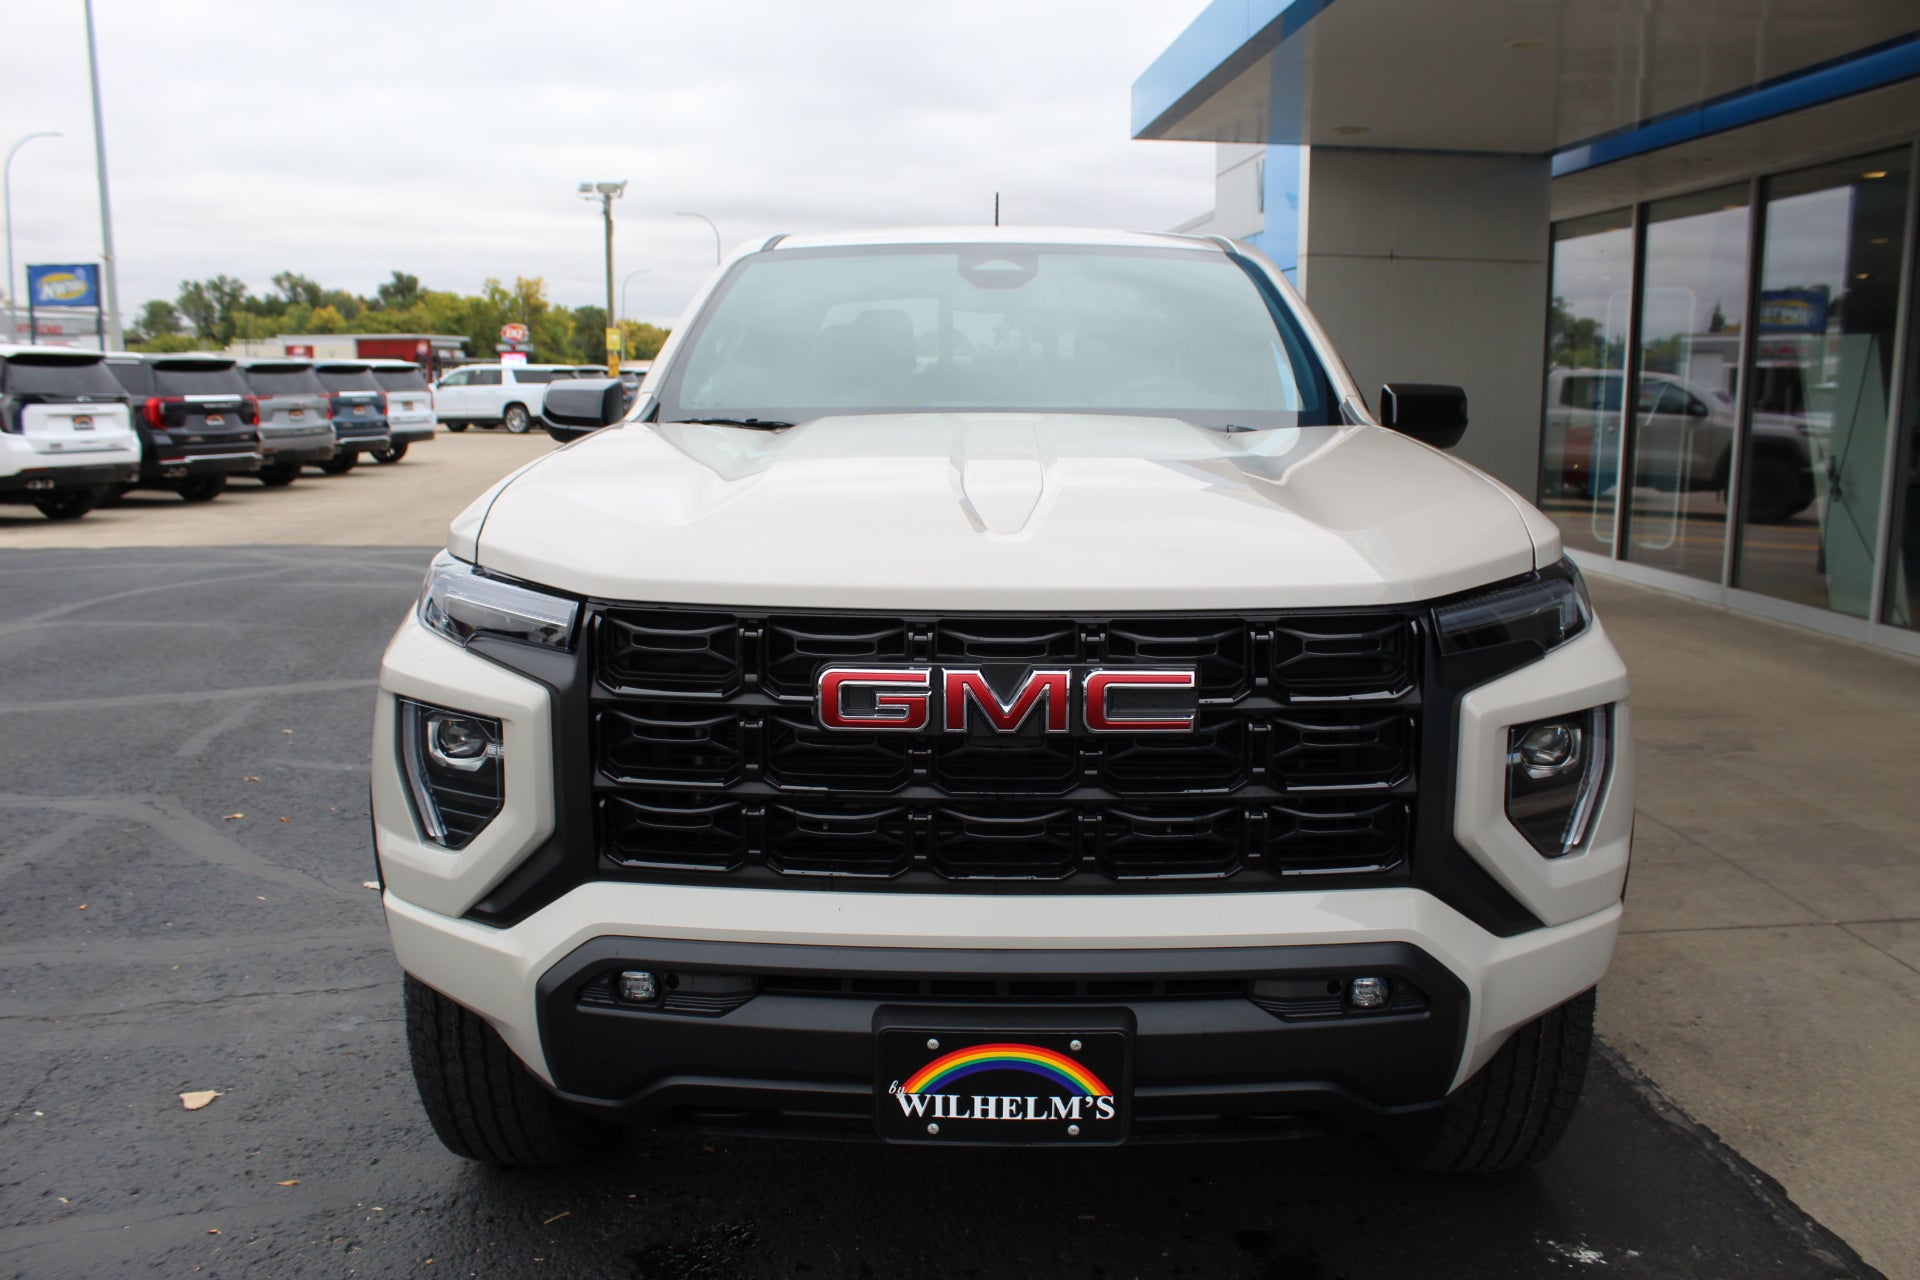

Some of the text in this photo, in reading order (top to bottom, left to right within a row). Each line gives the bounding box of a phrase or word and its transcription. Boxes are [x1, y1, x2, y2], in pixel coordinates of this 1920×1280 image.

[817, 667, 1195, 733] GMC
[888, 1080, 907, 1098] by
[896, 1093, 1115, 1120] WILHELM'S
